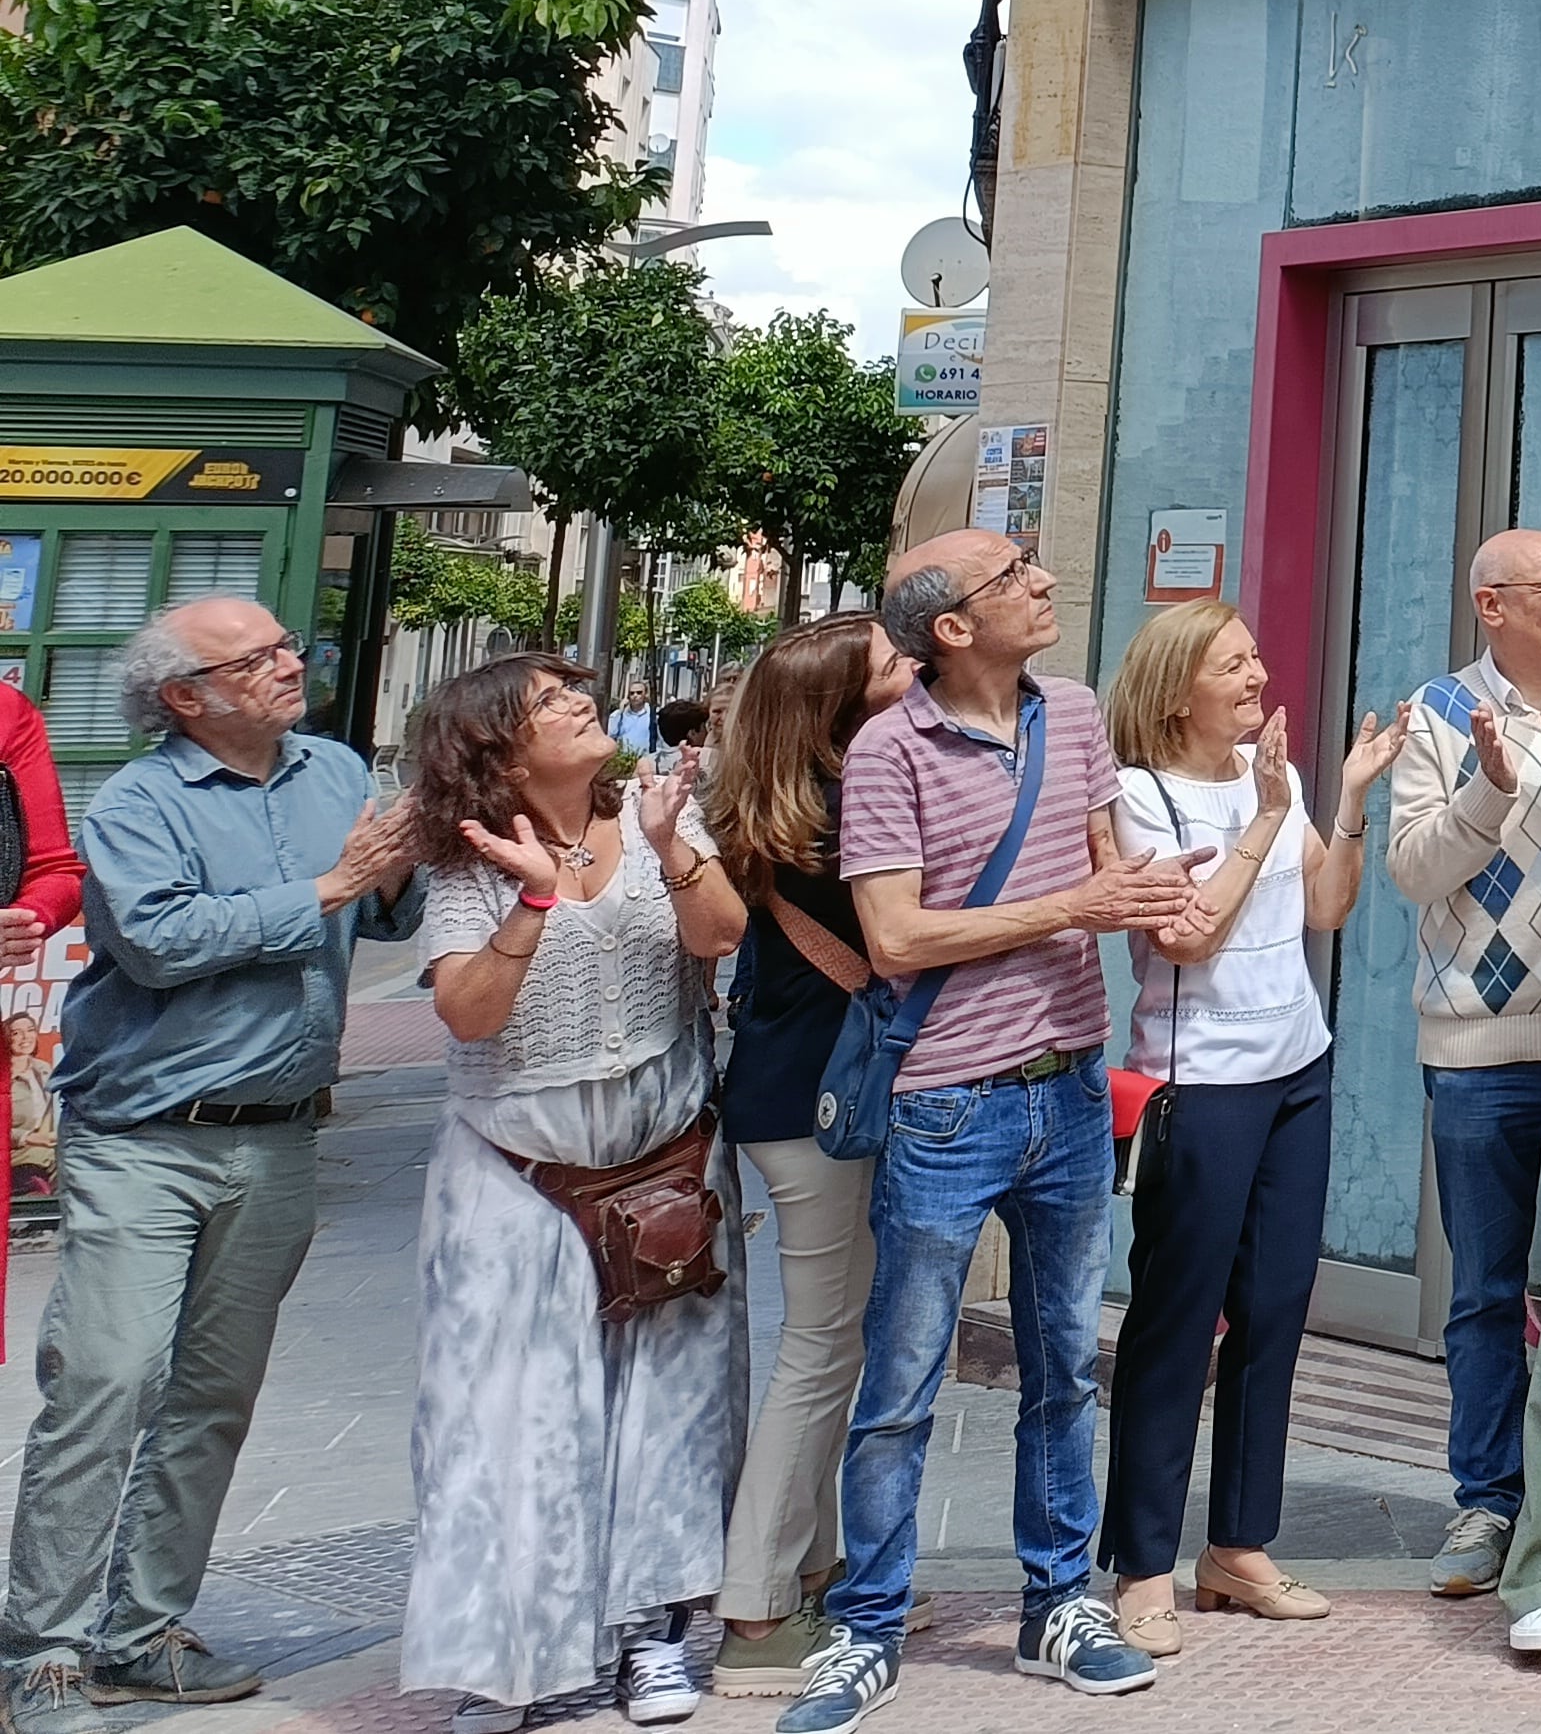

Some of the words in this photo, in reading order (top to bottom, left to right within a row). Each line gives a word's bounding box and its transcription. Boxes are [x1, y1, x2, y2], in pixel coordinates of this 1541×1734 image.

[924, 330, 986, 350] Deci
[939, 367, 965, 380] 691
[915, 389, 978, 401] HORARIO
